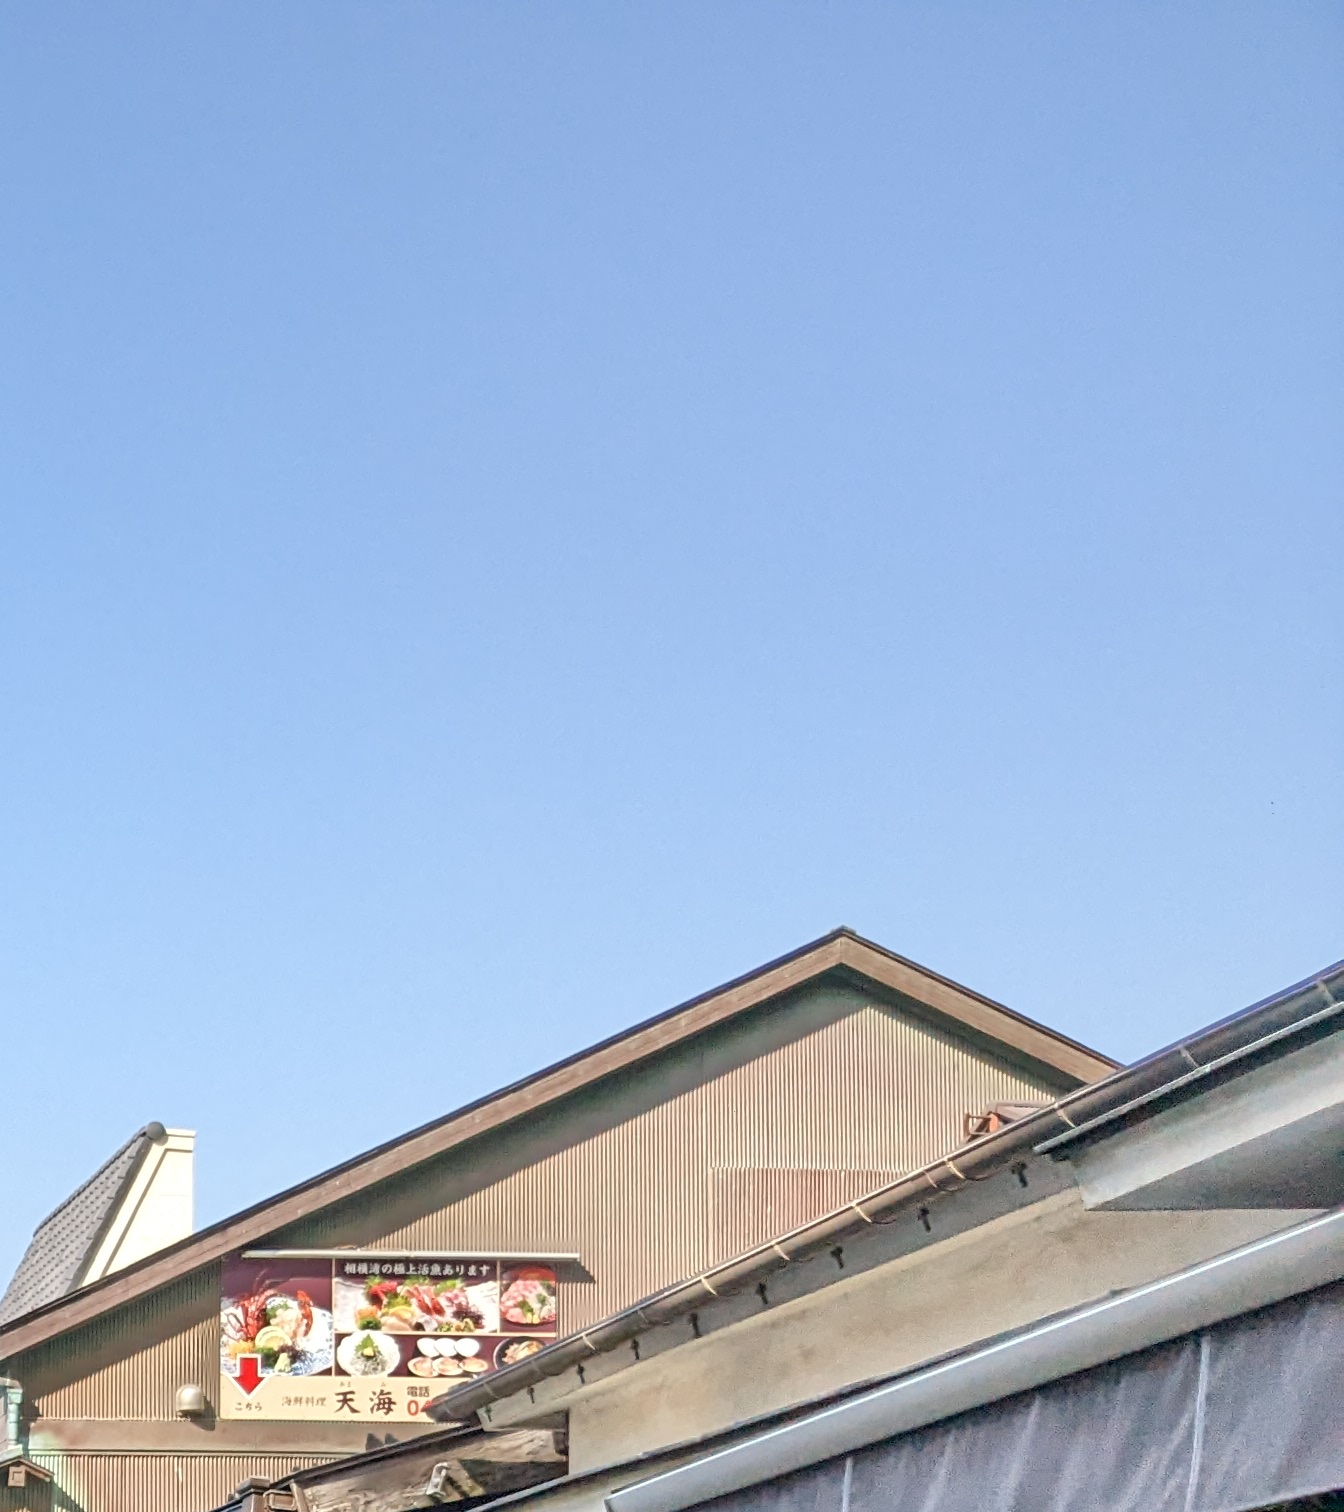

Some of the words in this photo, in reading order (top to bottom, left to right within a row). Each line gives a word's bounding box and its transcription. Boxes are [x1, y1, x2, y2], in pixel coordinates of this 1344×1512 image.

[344, 1262, 490, 1277] 相模湾の極上活魚あります
[407, 1386, 430, 1397] 電話
[235, 1401, 263, 1412] こちら
[281, 1396, 327, 1407] 海鮮料理
[334, 1389, 398, 1415] 天海
